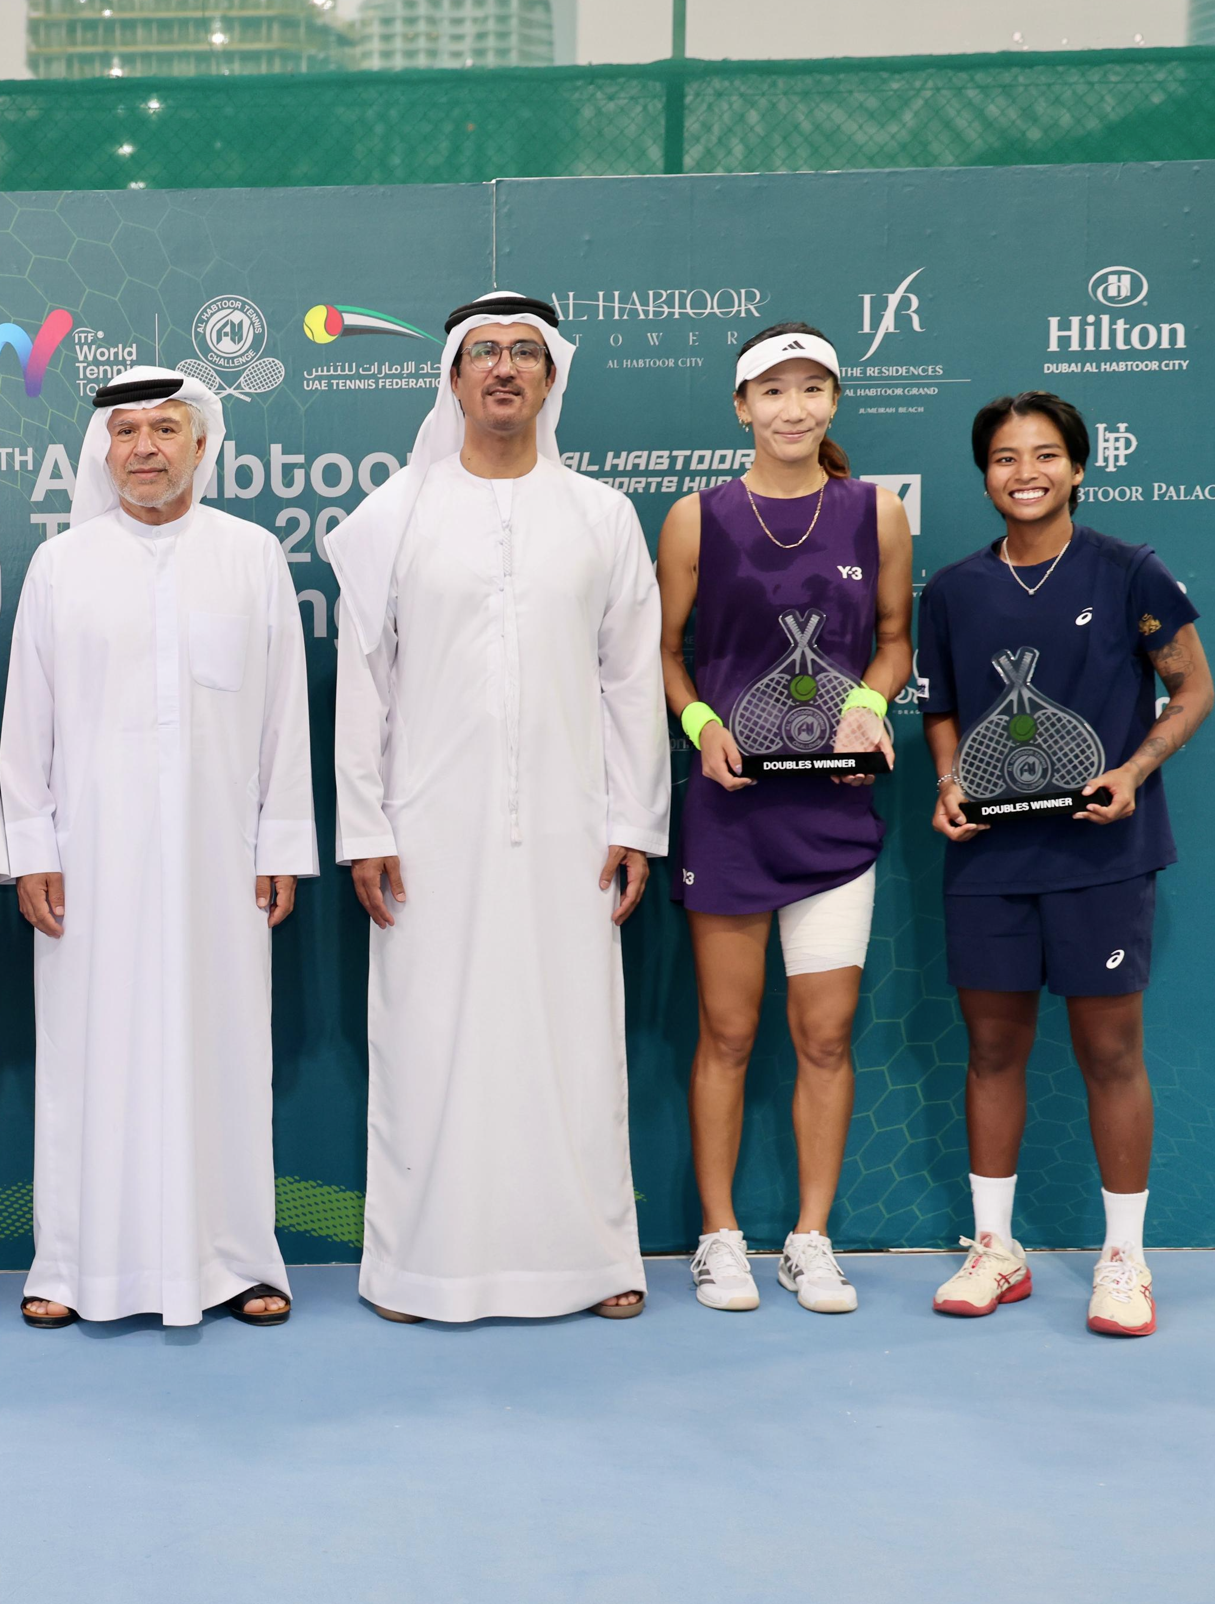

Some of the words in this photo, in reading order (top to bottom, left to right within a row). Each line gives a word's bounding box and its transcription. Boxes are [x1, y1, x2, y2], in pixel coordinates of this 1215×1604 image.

[597, 288, 761, 320] HABTOOR
[197, 322, 205, 333] AL
[201, 300, 242, 320] HABTOOR
[243, 305, 262, 334] TENNIS
[74, 333, 95, 343] ITF
[1047, 314, 1187, 351] Hilton
[75, 343, 137, 361] World
[208, 349, 256, 366] CHALLENGE
[75, 360, 132, 379] Tenni
[304, 362, 356, 379] للتنس
[359, 361, 415, 378] الإمارات
[606, 360, 620, 369] AL
[623, 359, 675, 369] HABTOOR
[678, 357, 705, 367] CITY
[840, 367, 864, 377] THE
[866, 365, 944, 377] RESIDENCES
[1044, 363, 1081, 374] DUBAI
[1083, 362, 1099, 373] AL
[1101, 361, 1159, 372] HABTOOR
[1161, 360, 1190, 371] CITY
[304, 380, 328, 390] UAE
[331, 379, 376, 390] TENNIS
[844, 389, 856, 397] AL
[857, 387, 904, 396] HABTOOR
[904, 387, 939, 395] GRAND
[560, 451, 600, 472] AL
[604, 449, 756, 471] HABTOOR
[1152, 482, 1215, 501] PALAC
[837, 565, 863, 580] Y-3
[763, 760, 812, 770] DOUBLES
[813, 758, 856, 769] WINNER
[981, 802, 1030, 816] DOUBLES
[1030, 797, 1073, 810] WINNER
